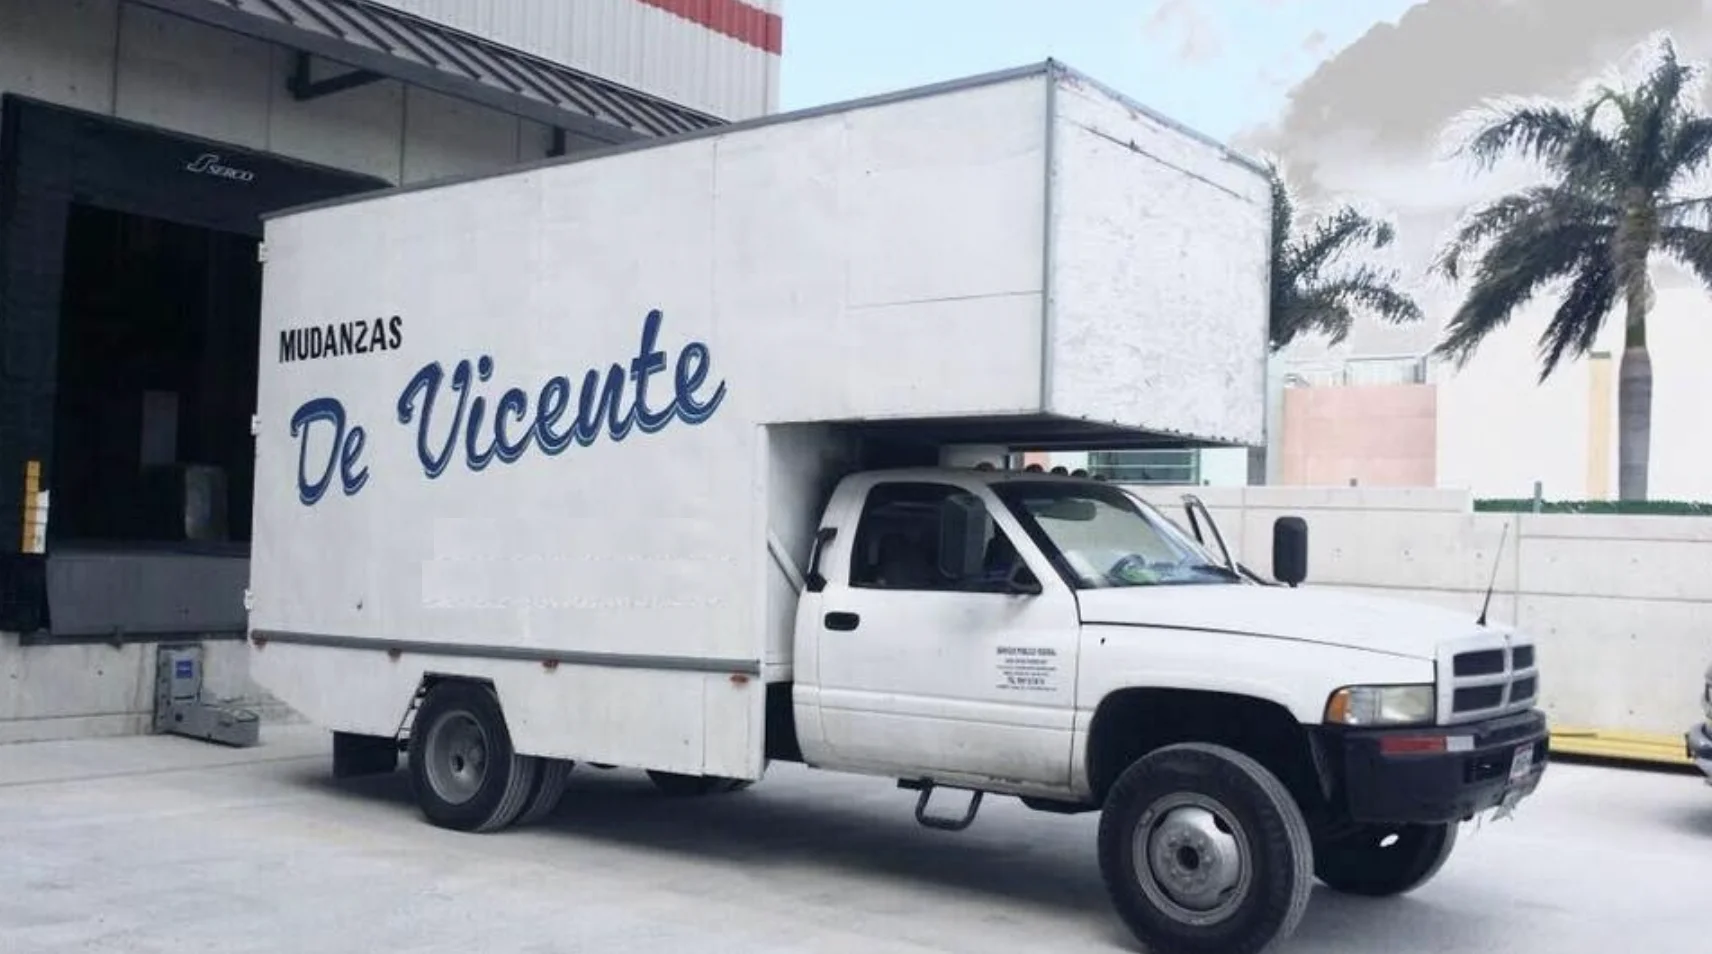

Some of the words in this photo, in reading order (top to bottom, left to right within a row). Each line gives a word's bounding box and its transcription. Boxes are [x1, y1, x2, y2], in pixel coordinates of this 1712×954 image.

[278, 315, 403, 364] MUDANZAS
[290, 396, 370, 507] De
[397, 308, 728, 480] Vicente
